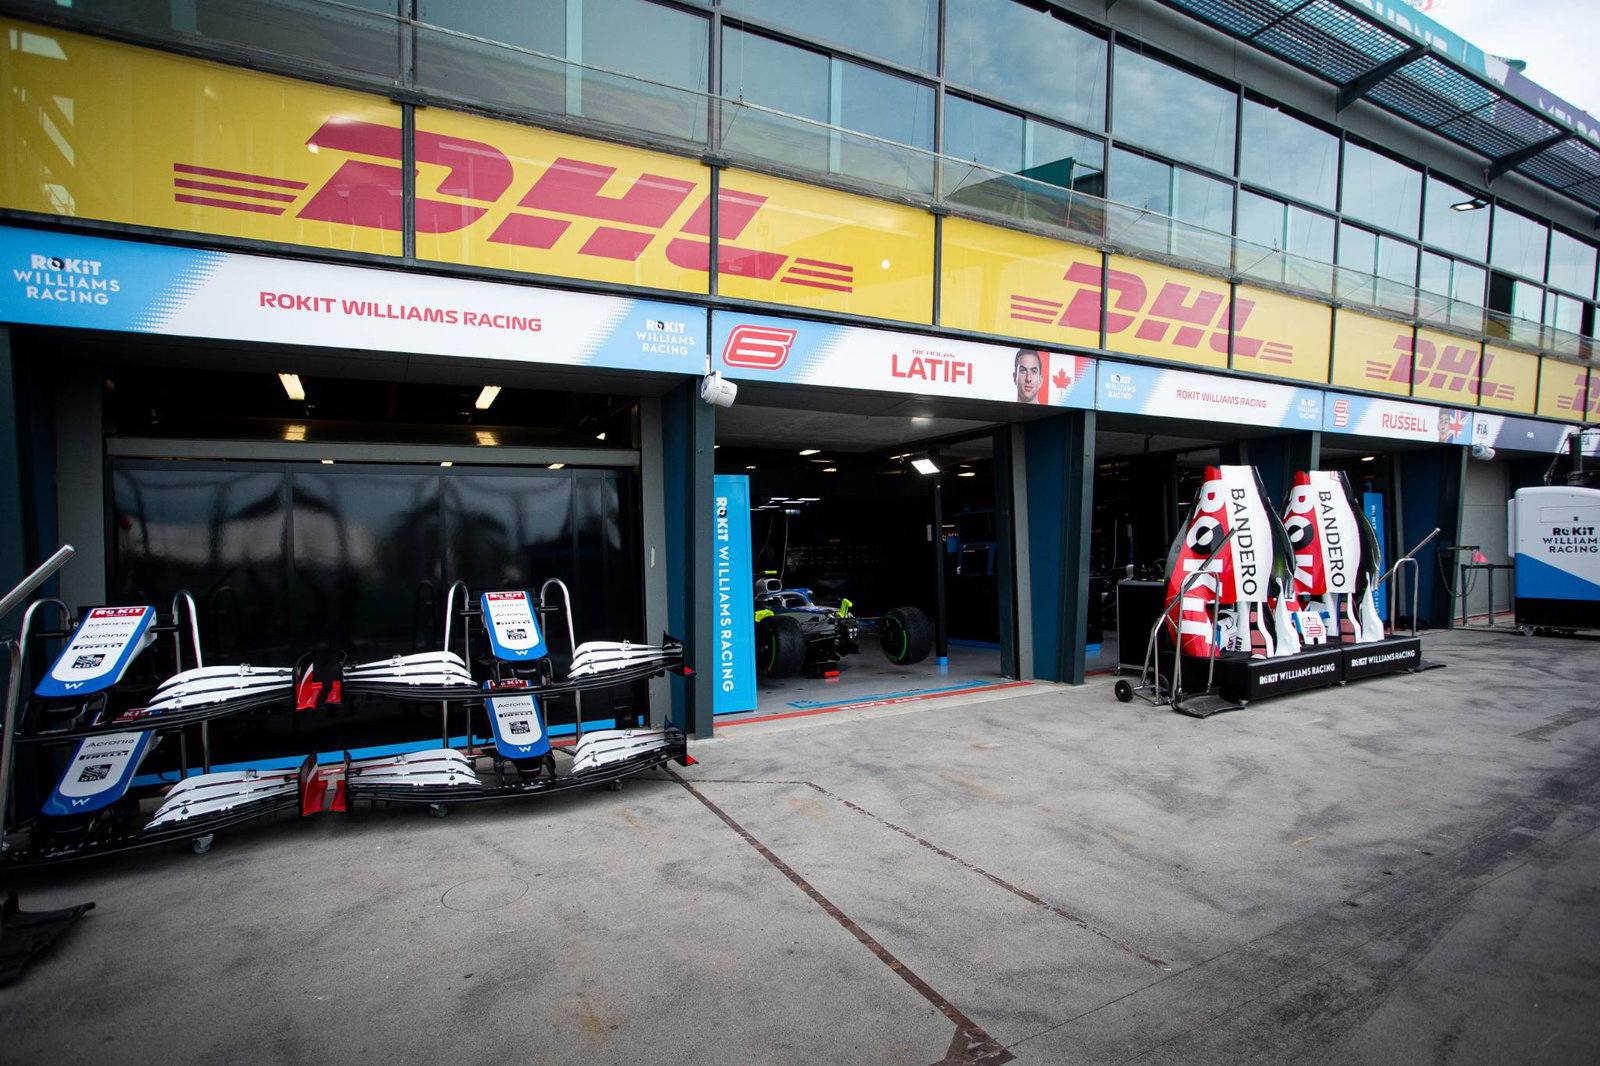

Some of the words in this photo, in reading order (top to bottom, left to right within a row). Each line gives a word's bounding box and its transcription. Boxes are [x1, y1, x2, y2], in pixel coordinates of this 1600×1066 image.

[295, 115, 789, 281] DHL
[13, 269, 121, 292] WILLIAMS
[26, 286, 109, 305] RACING
[259, 292, 336, 312] ROKIT
[342, 299, 458, 324] WILLIAMS
[463, 311, 542, 332] RACING
[1057, 261, 1264, 359] DHL
[636, 331, 695, 346] WILLIAMS
[723, 324, 798, 371] 6
[642, 343, 688, 356] RACING
[891, 354, 973, 385] LATIFI
[1387, 334, 1501, 398] DHL
[1176, 389, 1201, 401] ROKIT
[1202, 392, 1239, 406] WILLIAMS
[1240, 398, 1267, 409] RACING
[1382, 413, 1428, 433] RUSSELL
[1231, 488, 1257, 596] BANDERO
[1318, 491, 1346, 588] BANDERO
[1542, 537, 1600, 545] WILLIAM
[1549, 545, 1599, 553] RACING
[717, 547, 731, 625] WILLIAMS
[72, 642, 123, 650] PIRELLI
[720, 631, 734, 692] RACING
[1368, 653, 1395, 665] WILLIAMS
[1395, 650, 1416, 660] RACING
[1279, 667, 1311, 681] WILLIAMS
[1312, 663, 1335, 674] RACING
[86, 739, 135, 748] Acronis
[78, 750, 129, 760] PIRELLI
